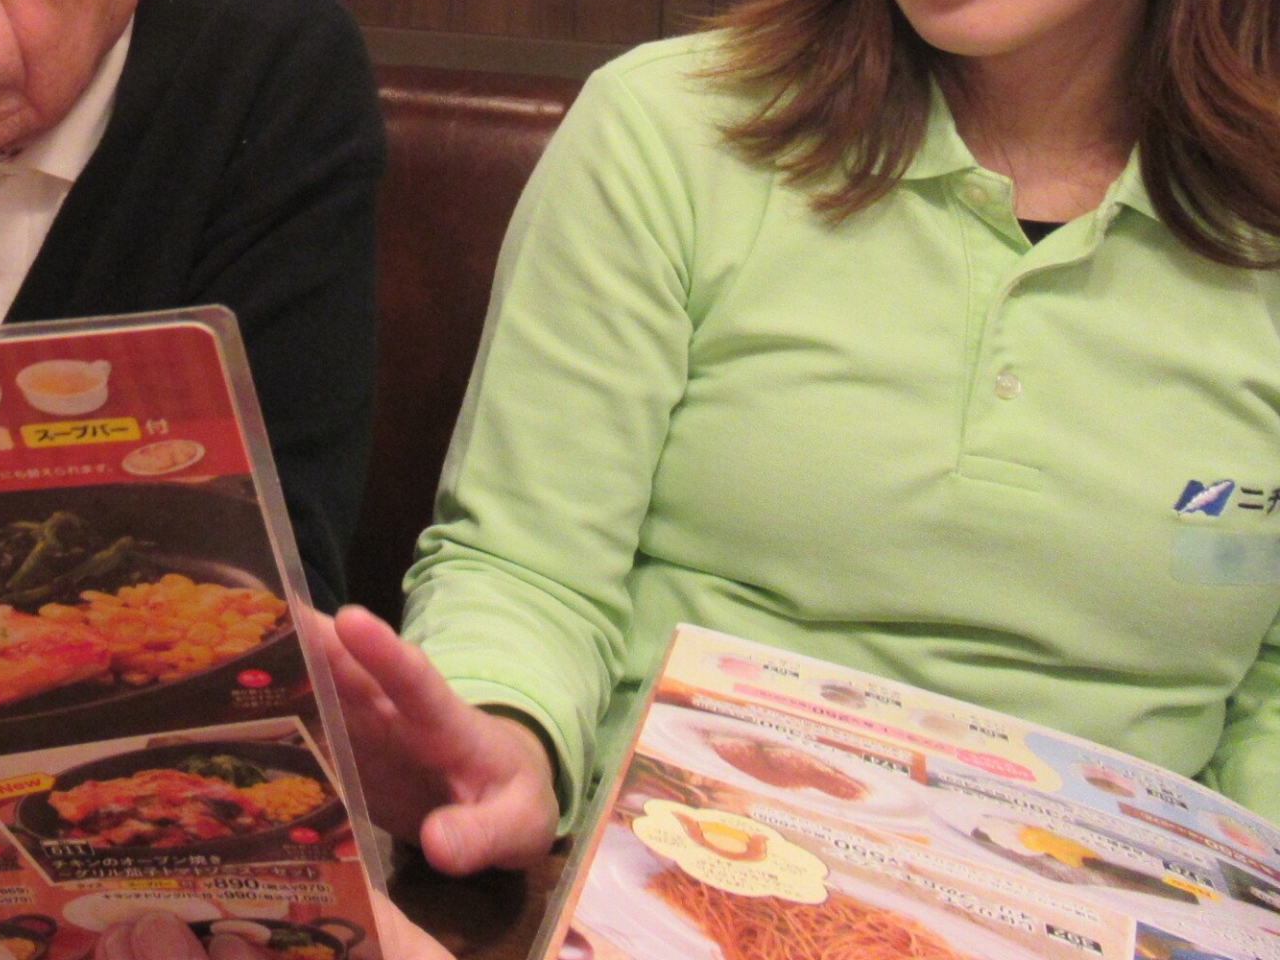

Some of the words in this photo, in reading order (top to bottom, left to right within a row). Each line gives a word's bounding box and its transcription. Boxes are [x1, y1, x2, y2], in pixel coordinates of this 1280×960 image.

[36, 424, 131, 442] スープバー
[145, 418, 170, 436] 付
